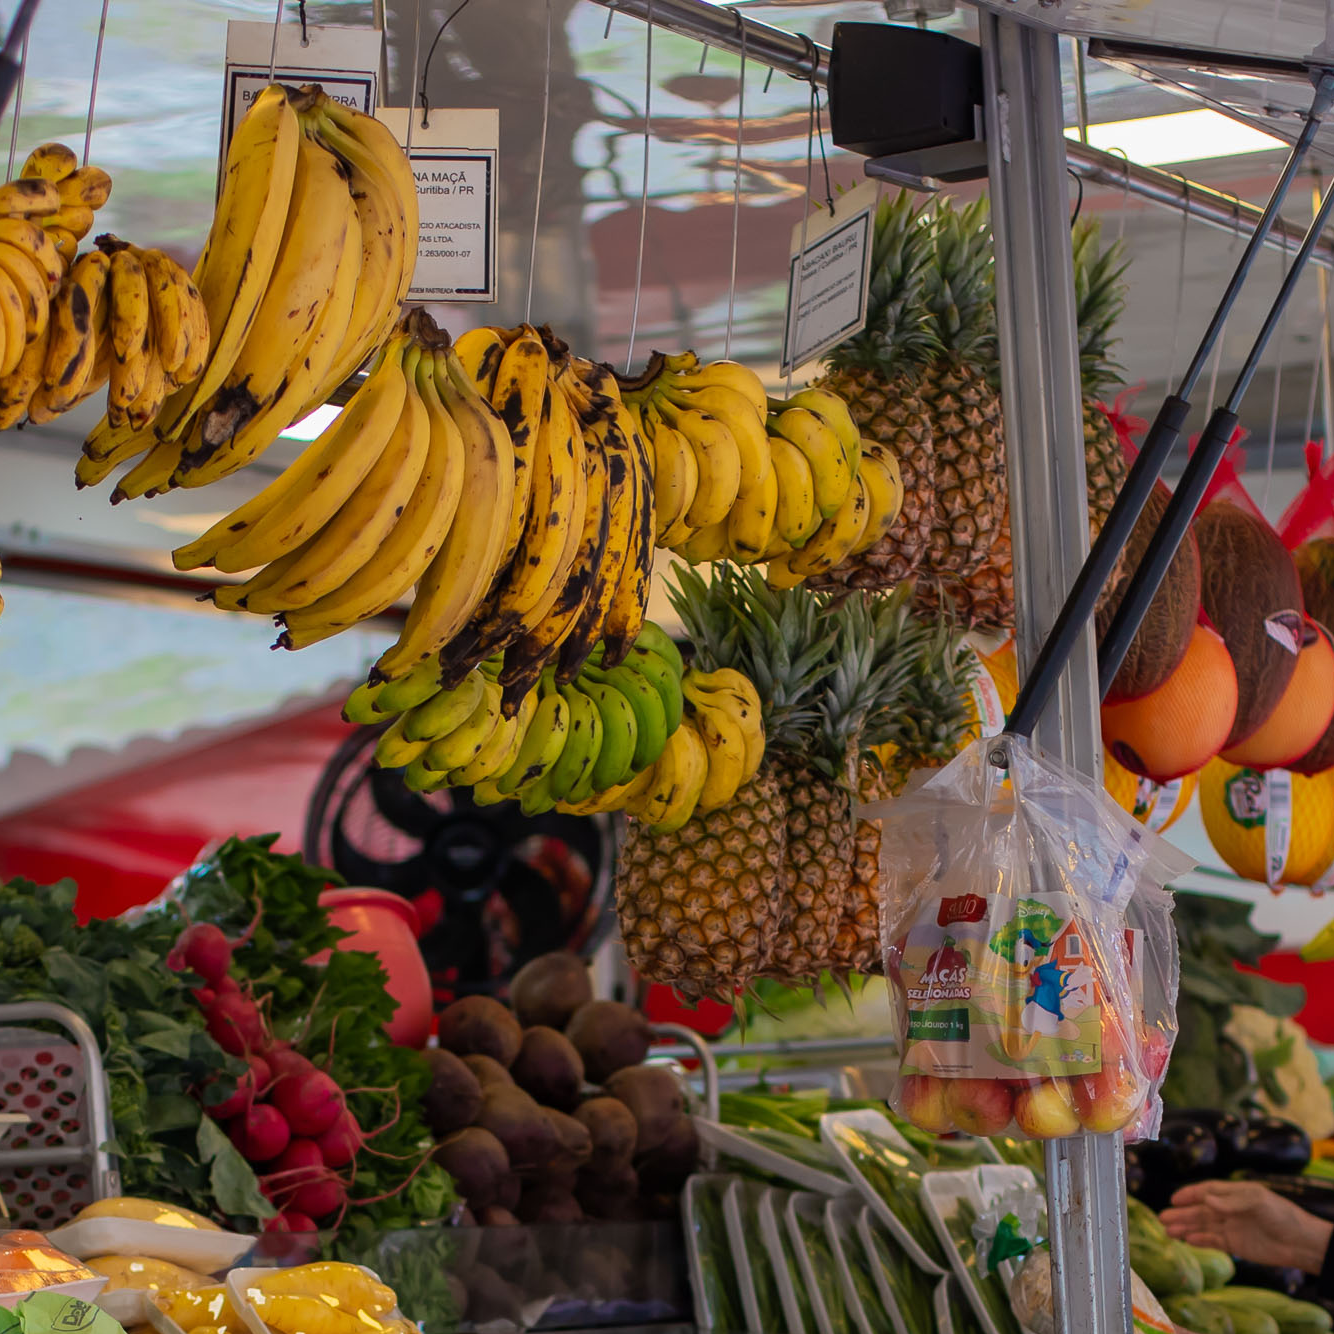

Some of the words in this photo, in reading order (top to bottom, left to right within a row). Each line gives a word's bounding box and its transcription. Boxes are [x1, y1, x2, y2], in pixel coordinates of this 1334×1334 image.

[413, 172, 428, 182] NA
[432, 171, 466, 184] MAÇÃ
[459, 186, 474, 195] PR
[435, 222, 481, 230] ATACADISTA
[417, 250, 471, 258] 1.263/0001-07
[1017, 906, 1050, 918] Disney
[919, 965, 966, 987] MAÇÃS
[907, 988, 970, 999] SELEIONADAS
[62, 1300, 92, 1326] Dole
